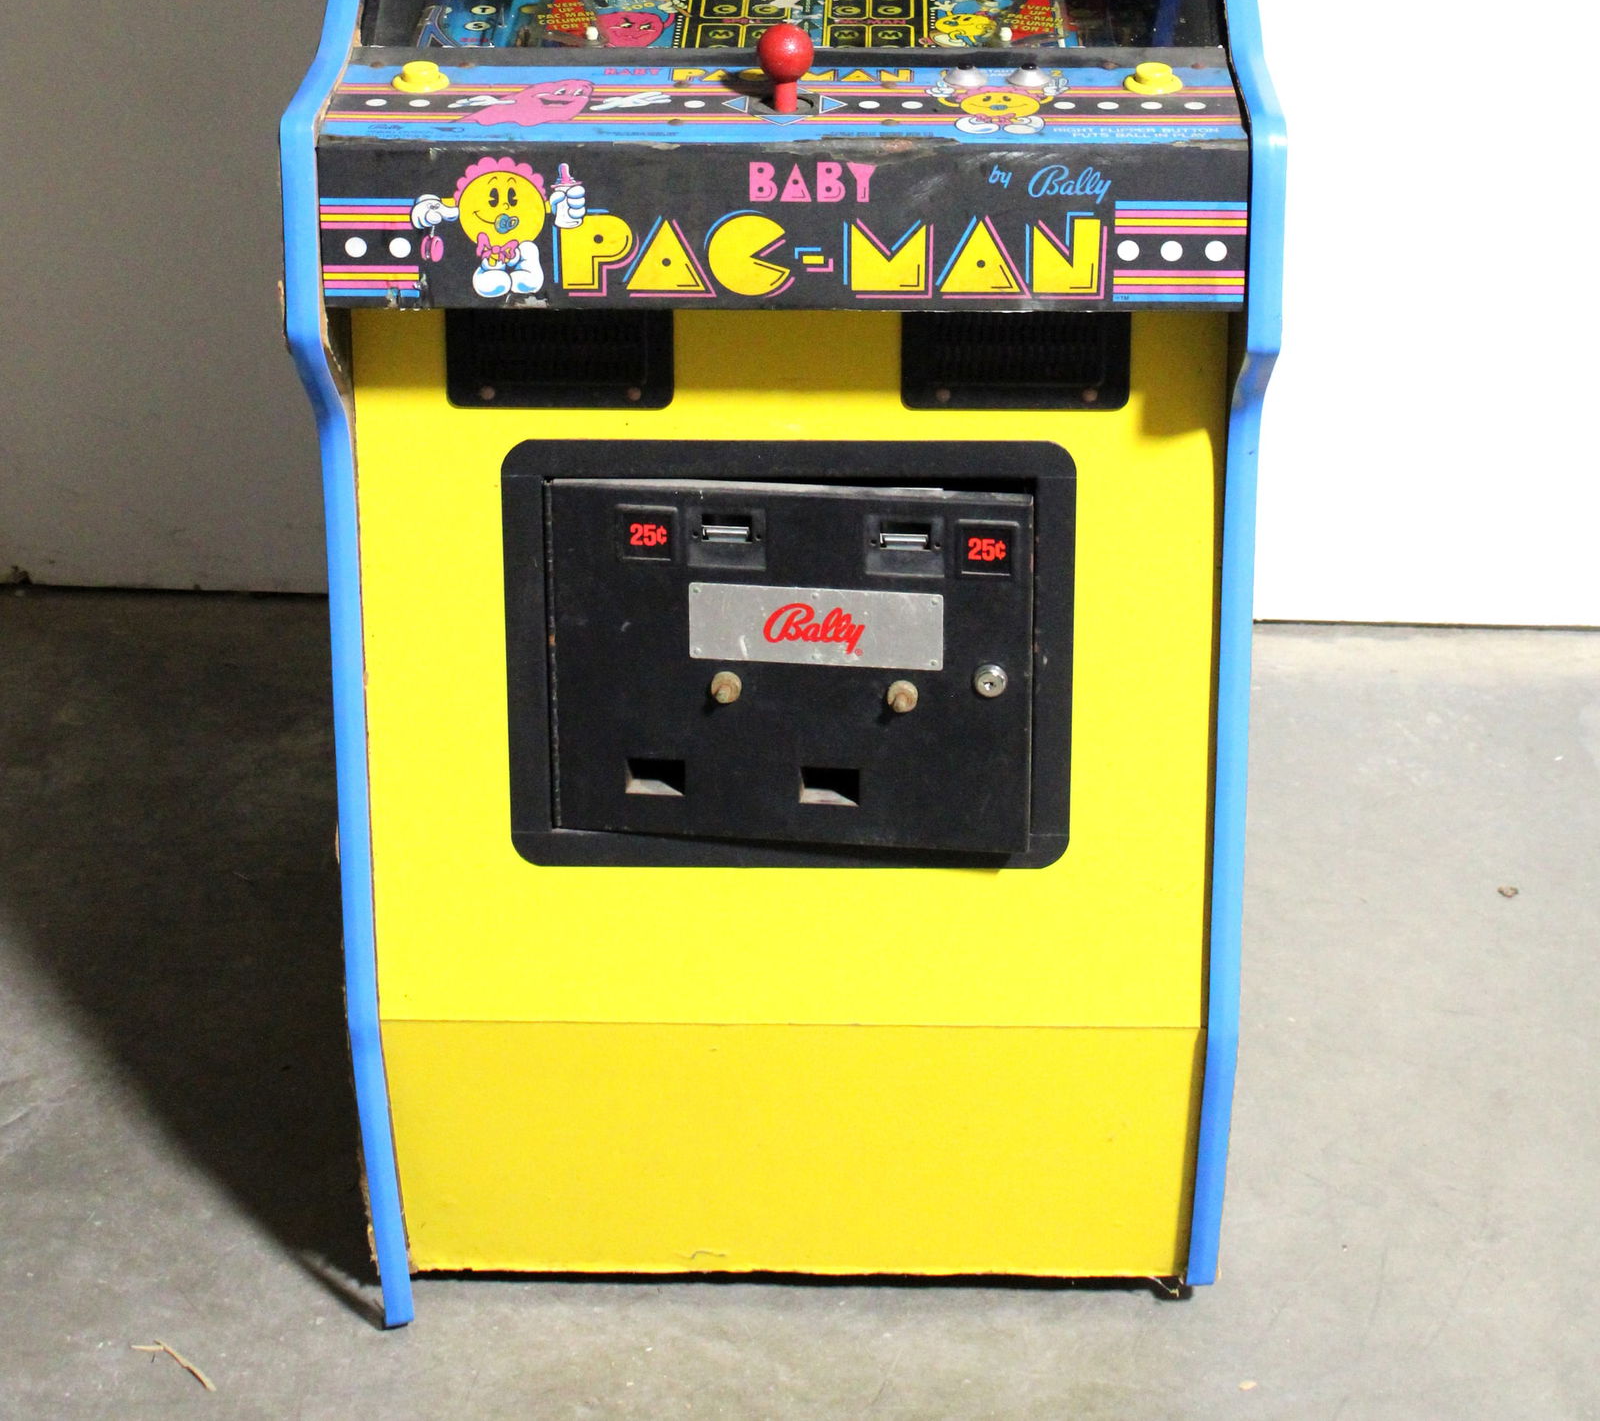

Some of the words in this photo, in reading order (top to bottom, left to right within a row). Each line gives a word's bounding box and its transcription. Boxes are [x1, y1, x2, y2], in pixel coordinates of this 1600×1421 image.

[749, 162, 878, 203] BABY
[989, 164, 1011, 188] by
[1027, 164, 1112, 204] Bally
[553, 209, 1107, 300] PAC-MAN
[630, 523, 668, 547] 25¢
[967, 538, 1006, 562] 25¢
[762, 603, 866, 654] Bally
